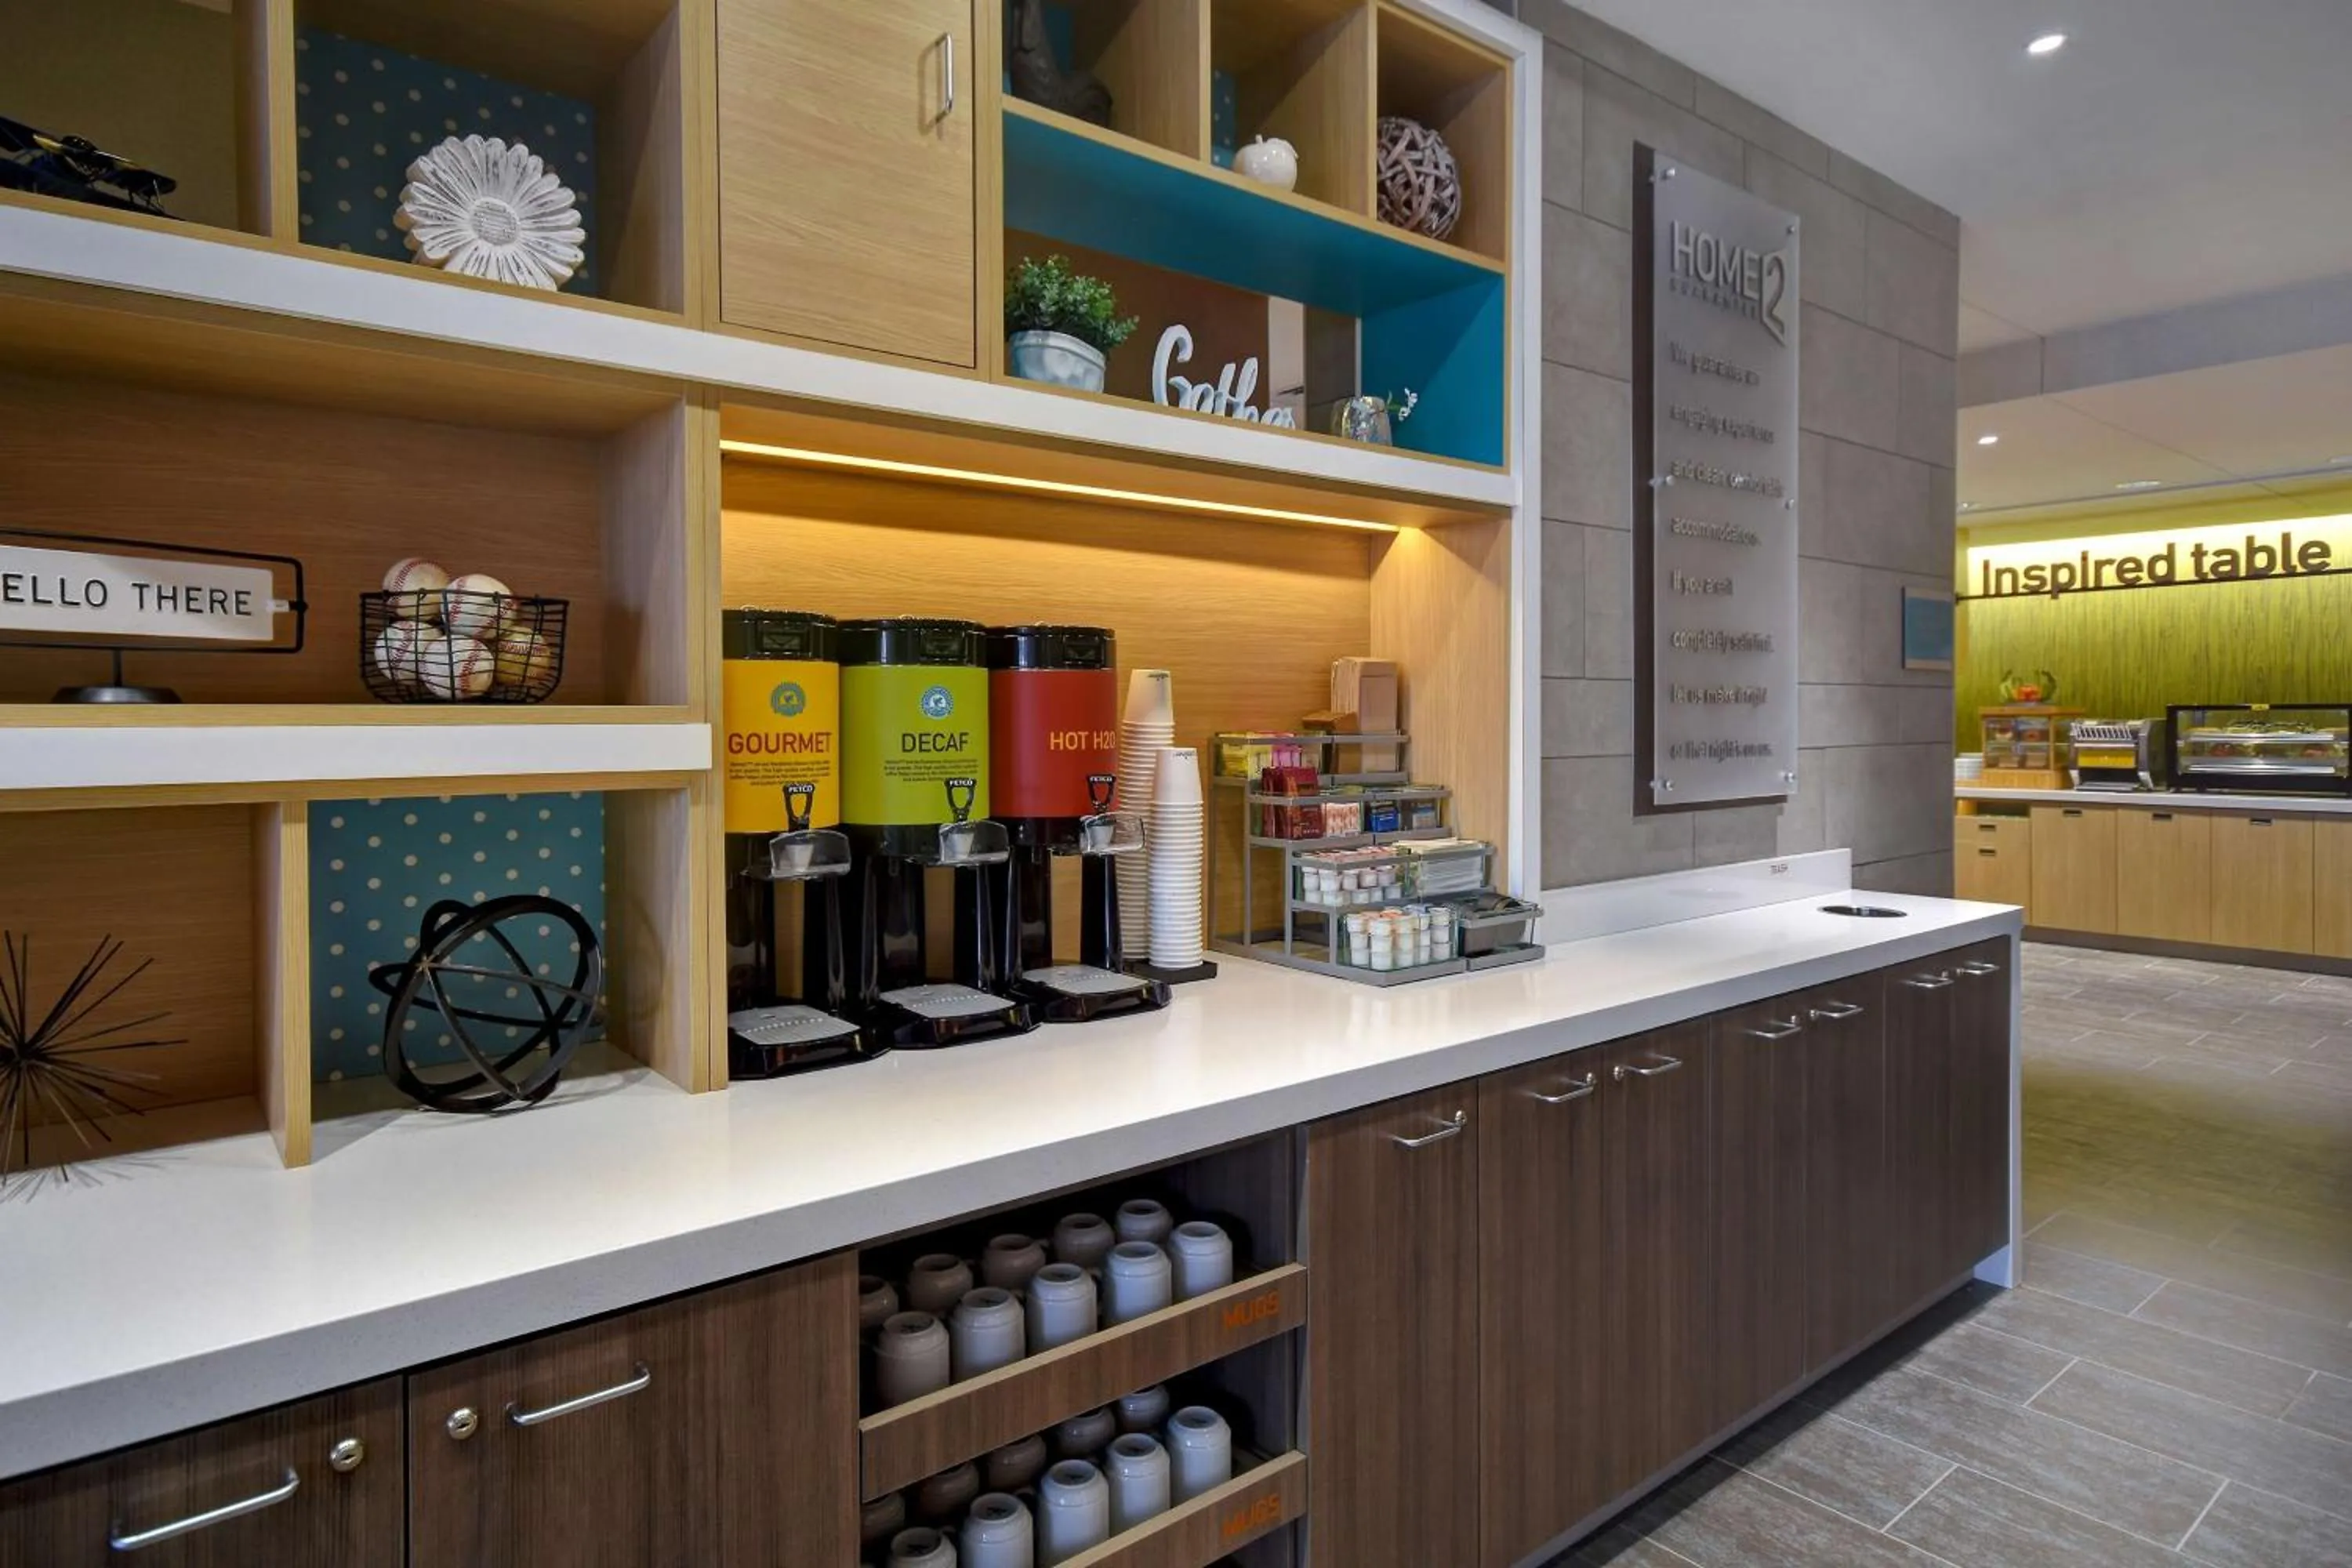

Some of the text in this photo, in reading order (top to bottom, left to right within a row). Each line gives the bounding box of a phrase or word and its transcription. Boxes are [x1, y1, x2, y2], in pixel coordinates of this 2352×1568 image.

[2191, 532, 2332, 581] table
[132, 581, 253, 617] THERE
[728, 731, 833, 754] GOURMET
[902, 731, 969, 753] DECAF
[1050, 731, 1089, 750] HOT
[1223, 1290, 1280, 1330] MUGS
